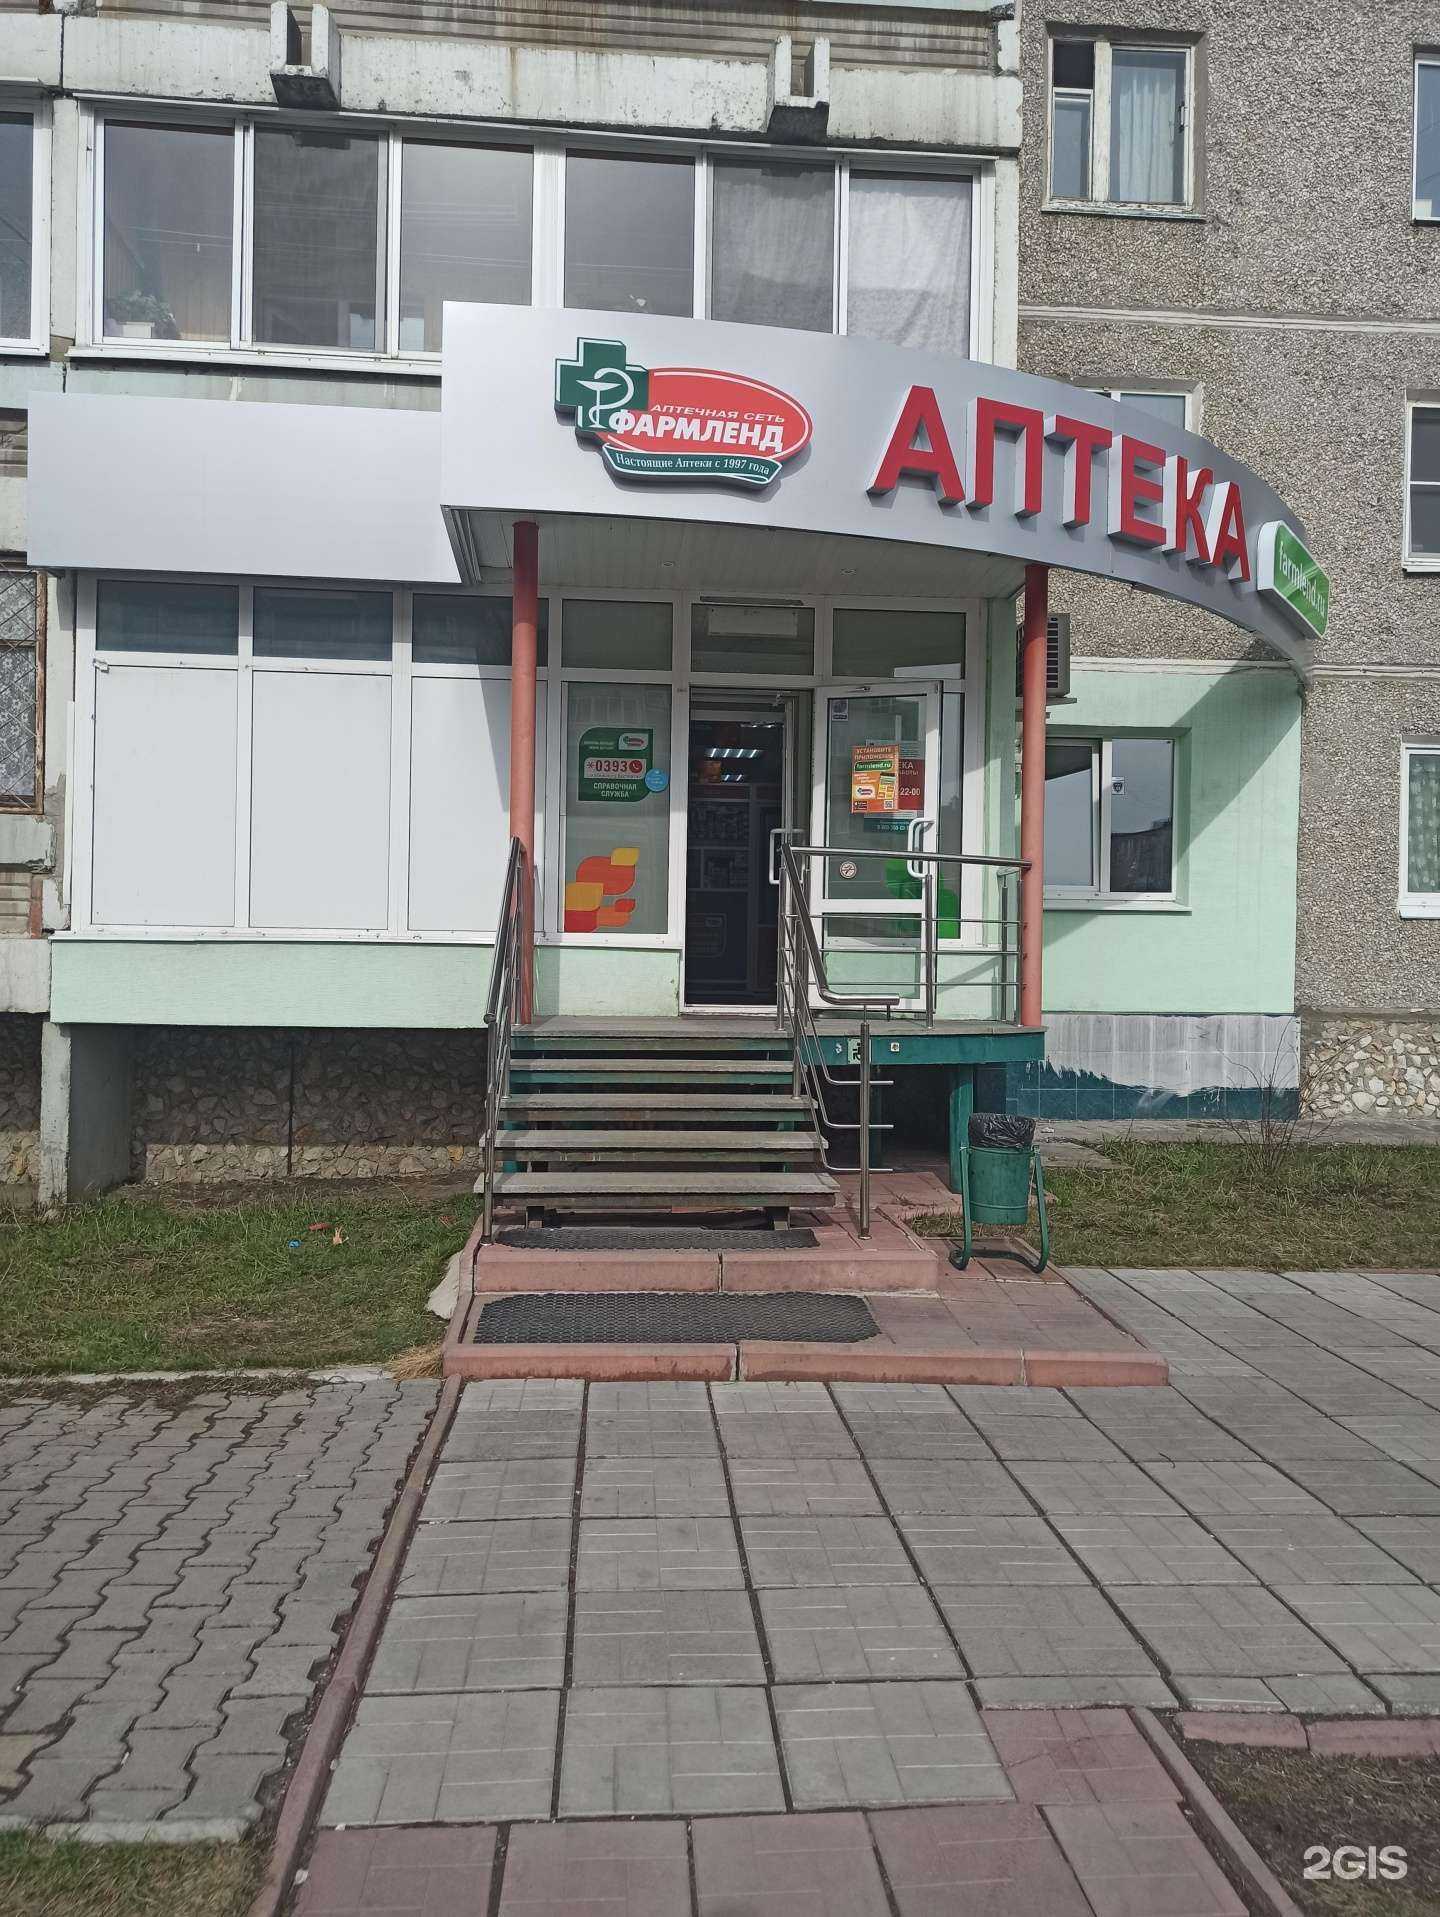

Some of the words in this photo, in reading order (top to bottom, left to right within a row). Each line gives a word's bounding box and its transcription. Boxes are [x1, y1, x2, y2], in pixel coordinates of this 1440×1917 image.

[650, 404, 739, 419] АПТЕЧНАЯ
[743, 412, 785, 423] СЕТЬ
[608, 409, 784, 453] ФАРМЛЕНД
[615, 452, 673, 468] Настоящие
[675, 457, 712, 468] Аптеки
[714, 460, 721, 468] с
[723, 458, 747, 469] 1997
[748, 462, 770, 475] года
[867, 384, 1251, 583] АПТЕКА
[1279, 540, 1326, 618] farmlend.ru
[593, 782, 637, 790] СПРАВОЧНАЯ
[601, 790, 630, 798] СЛУЖБА
